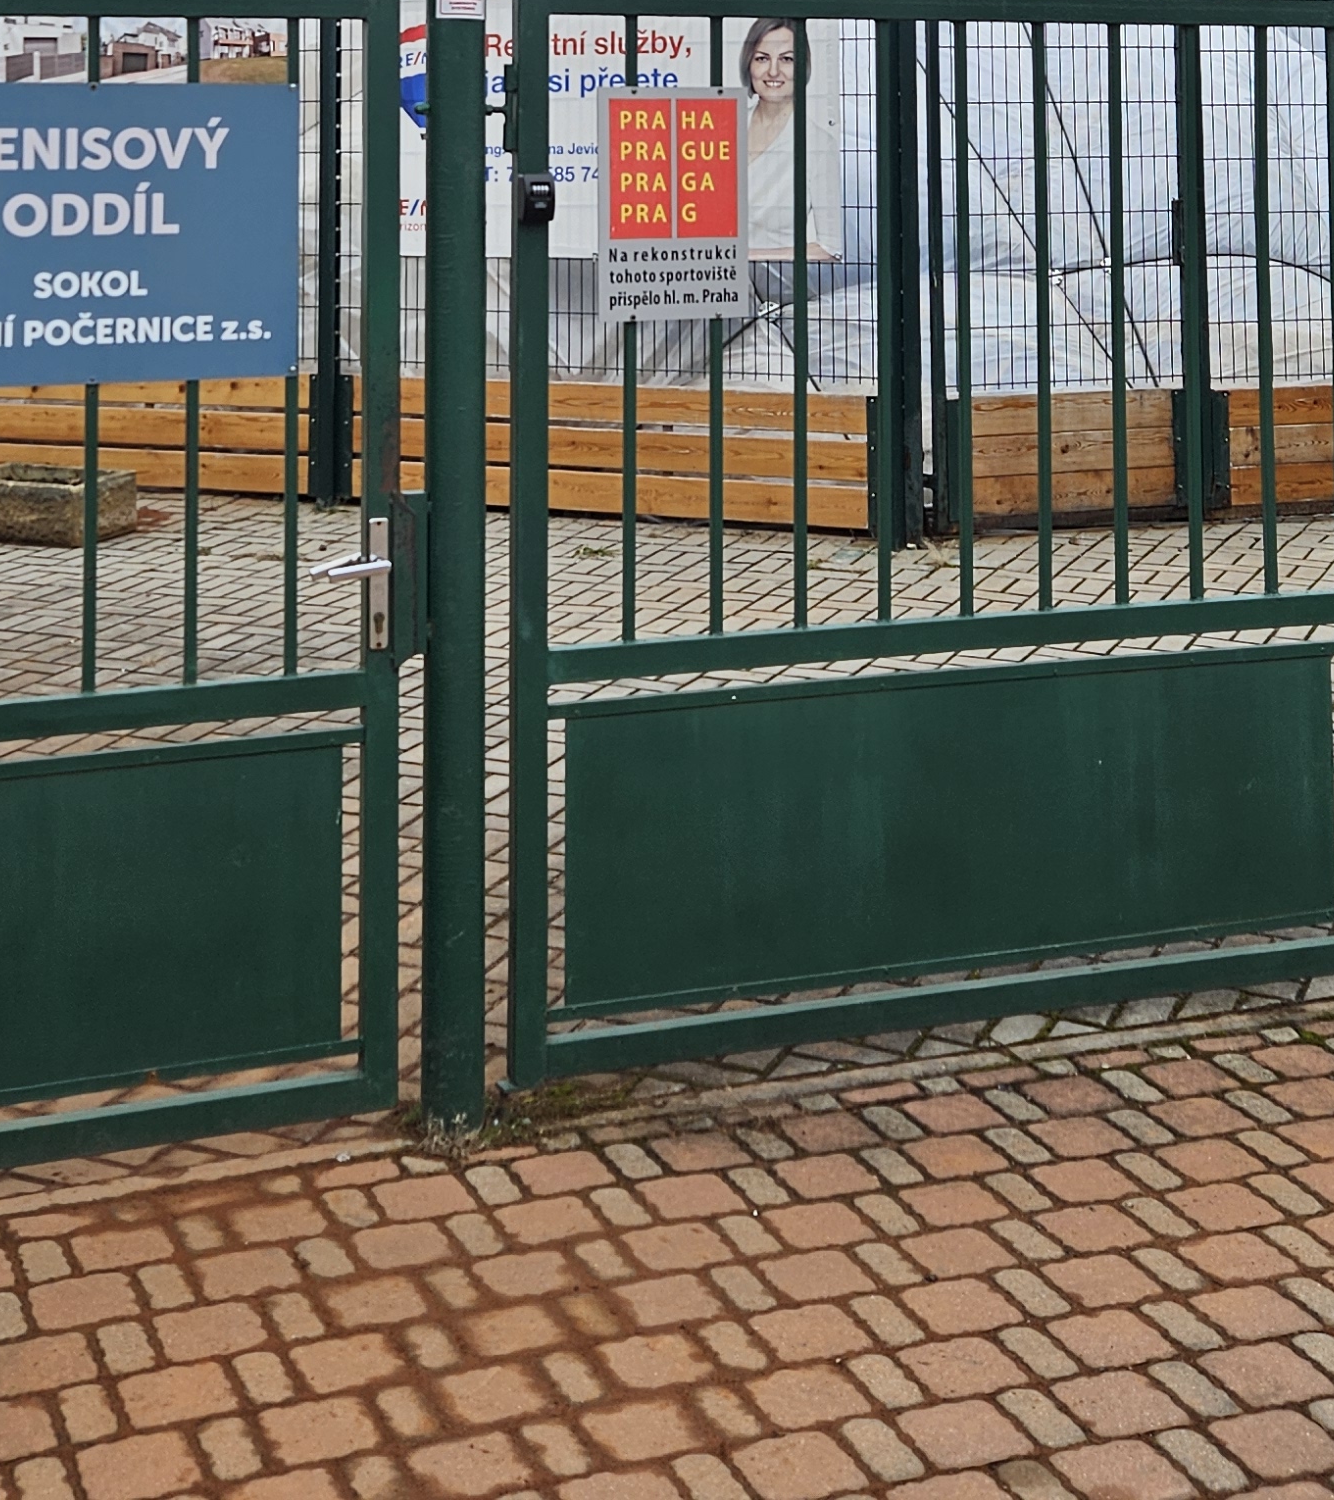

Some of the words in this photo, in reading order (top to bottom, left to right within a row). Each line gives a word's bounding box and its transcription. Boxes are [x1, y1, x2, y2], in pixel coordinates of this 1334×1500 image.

[484, 31, 587, 57] Retní
[594, 30, 691, 59] služby,
[547, 68, 570, 93] si
[580, 67, 679, 98] přeete
[619, 110, 666, 130] PRA
[680, 110, 715, 130] HA
[567, 142, 599, 155] Jevi
[620, 141, 666, 161] PRA
[680, 140, 731, 161] GUE
[581, 166, 599, 182] 74
[620, 172, 667, 192] PRA
[680, 172, 715, 192] GA
[1, 181, 181, 237] ODDÍL
[620, 203, 667, 223] PRA
[680, 202, 698, 223] G
[608, 248, 628, 263] Na
[633, 245, 737, 263] rekonstrukci
[33, 269, 149, 299] SOKOL
[609, 269, 656, 284] tohoto
[659, 266, 737, 286] sportoviště
[609, 291, 660, 311] přispělo
[663, 290, 680, 305] hl.
[683, 293, 699, 304] m.
[702, 288, 739, 304] Praha
[23, 312, 214, 348] POČERNICE
[220, 319, 273, 342] z.s.
